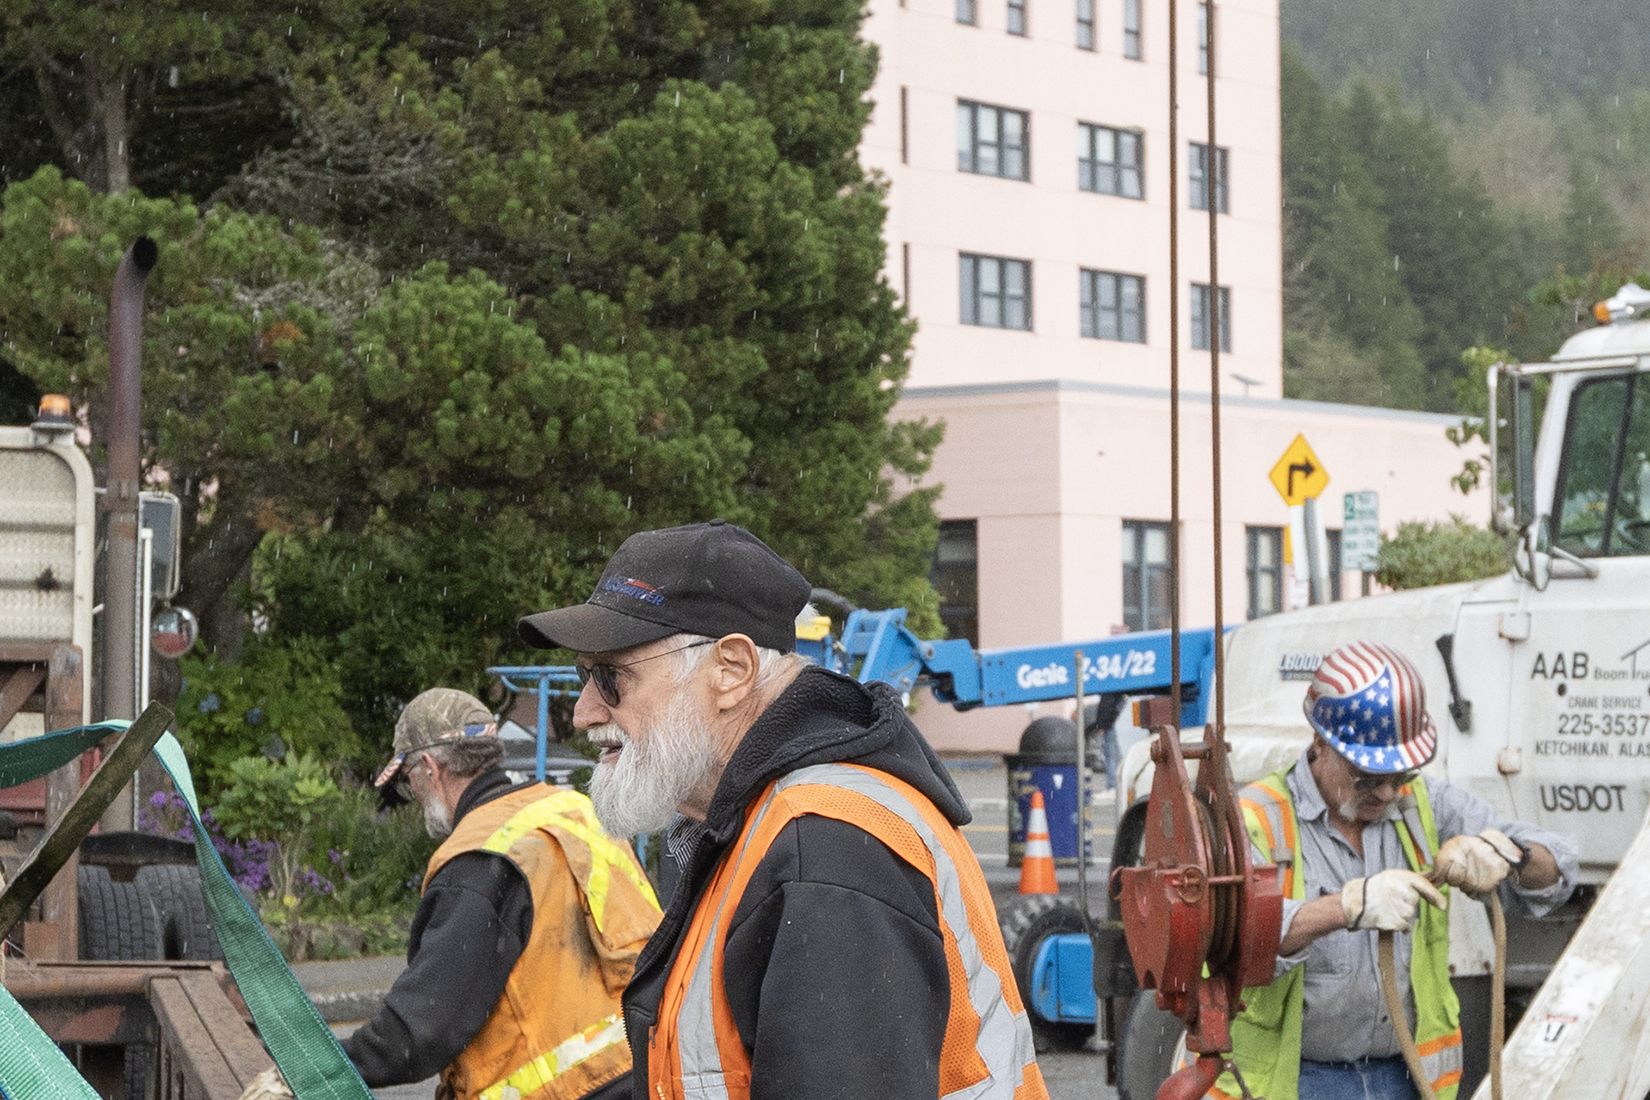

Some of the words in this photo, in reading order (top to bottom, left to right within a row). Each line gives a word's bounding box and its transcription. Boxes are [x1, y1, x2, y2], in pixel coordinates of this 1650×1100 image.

[1016, 662, 1069, 689] Genie
[1531, 651, 1590, 680] AAB
[1593, 667, 1629, 680] Boom
[1568, 696, 1598, 709] CRANE
[1602, 696, 1642, 709] SERVICE
[1558, 713, 1650, 737] 225-3537
[1539, 784, 1627, 812] USDOT
